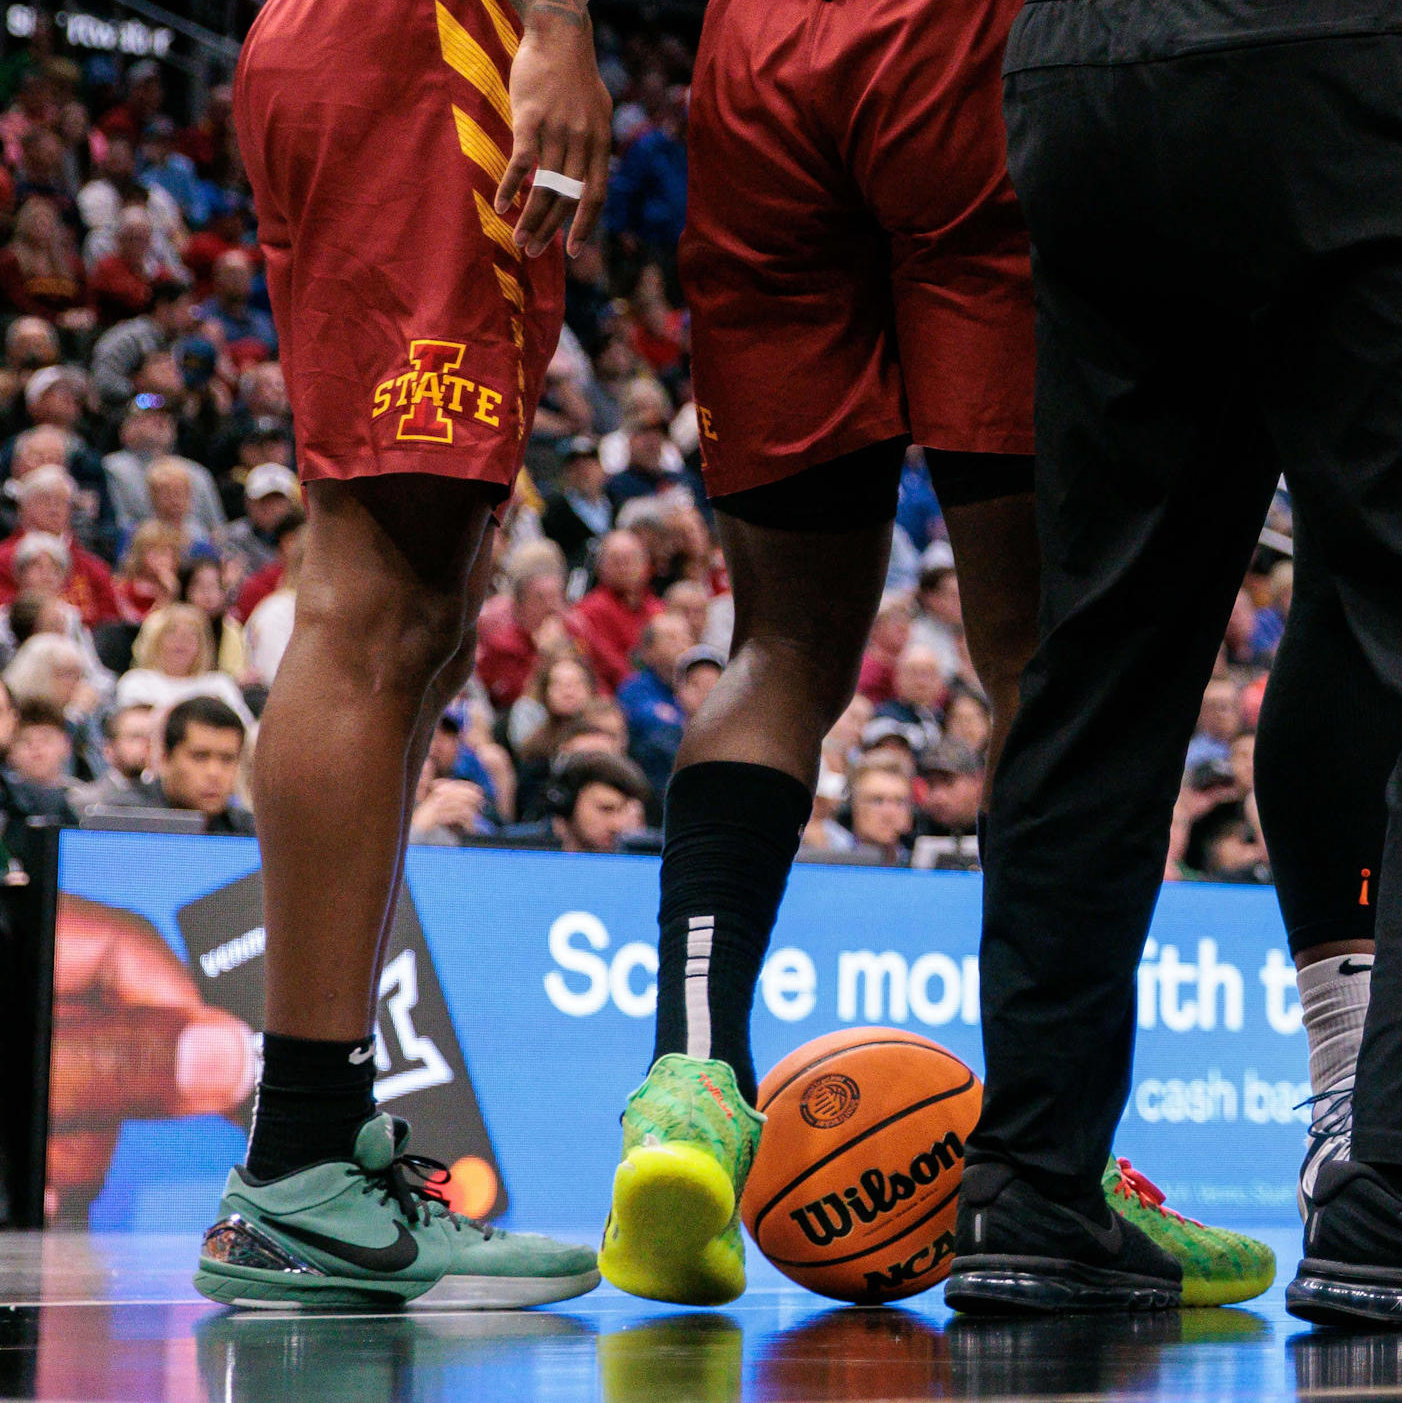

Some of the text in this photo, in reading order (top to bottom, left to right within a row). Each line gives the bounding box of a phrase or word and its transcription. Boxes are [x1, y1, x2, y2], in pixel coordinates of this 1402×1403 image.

[372, 371, 503, 429] STATE
[544, 911, 817, 1022] Sce
[1135, 937, 1244, 1032] ith
[1135, 1068, 1237, 1127] cash
[789, 1130, 965, 1247] Wilson
[863, 1229, 956, 1293] NCA
